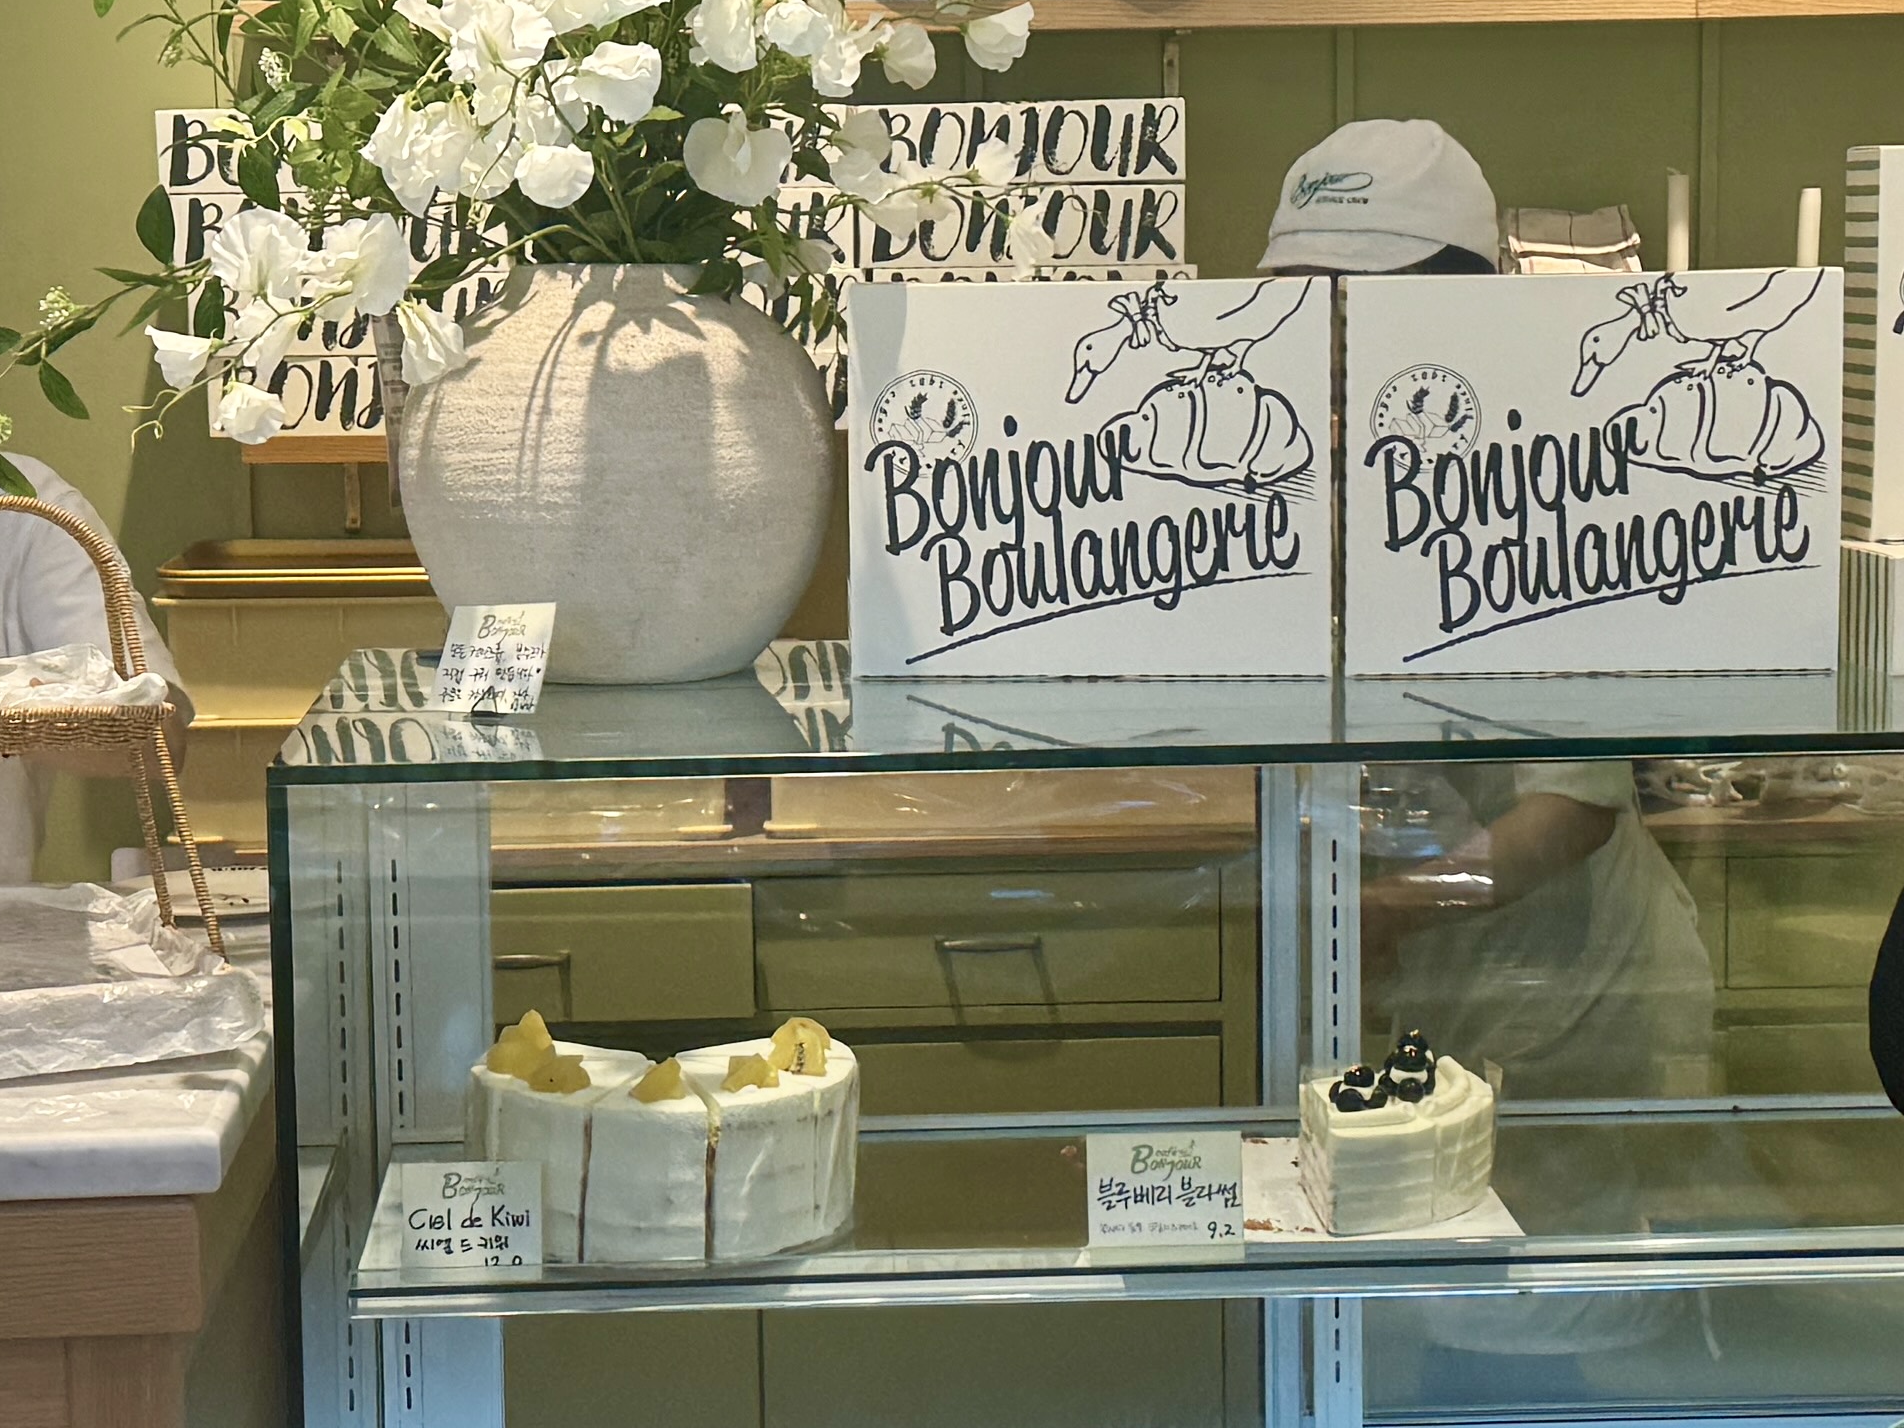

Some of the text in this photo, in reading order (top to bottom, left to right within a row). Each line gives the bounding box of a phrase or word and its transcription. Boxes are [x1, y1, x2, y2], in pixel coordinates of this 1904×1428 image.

[865, 415, 1141, 556] Bonjour
[1365, 409, 1649, 550] Bonjour
[920, 490, 1300, 637] Boulangerie
[1421, 480, 1808, 634] Boulangerie
[461, 1205, 483, 1228] de
[491, 1204, 530, 1227] Kiwi
[1097, 1177, 1172, 1211] 블루베리
[1208, 1221, 1235, 1239] 9.2
[460, 1238, 473, 1253] 드
